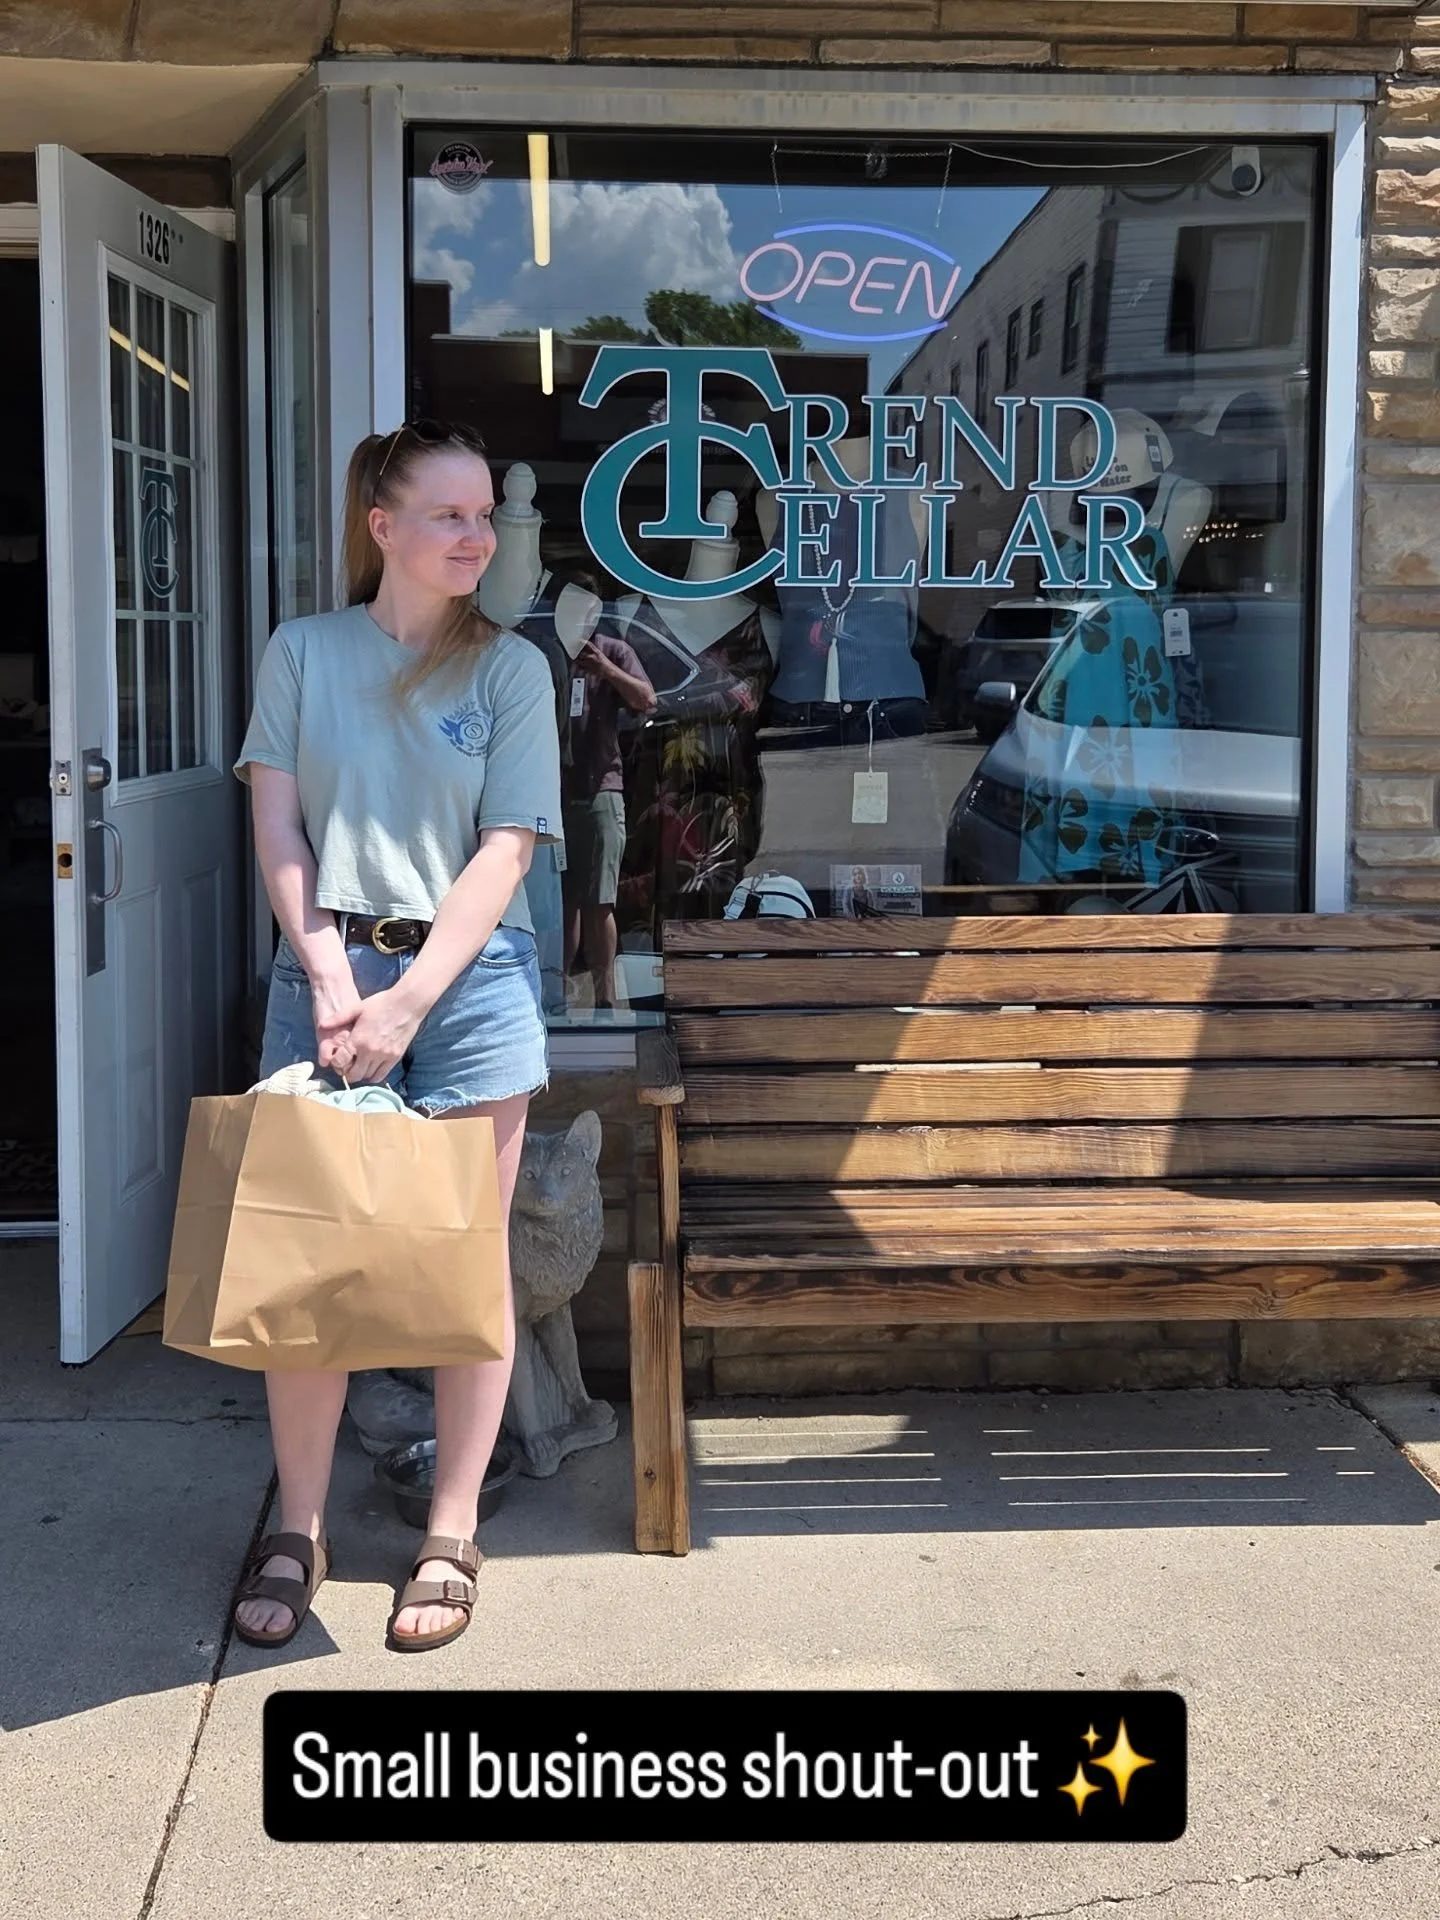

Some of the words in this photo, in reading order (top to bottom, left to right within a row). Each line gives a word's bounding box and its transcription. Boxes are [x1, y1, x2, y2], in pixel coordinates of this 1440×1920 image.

[139, 211, 170, 265] 1326
[739, 241, 961, 320] OPEN
[578, 345, 1117, 538] TREND
[580, 420, 1157, 601] CELLAR
